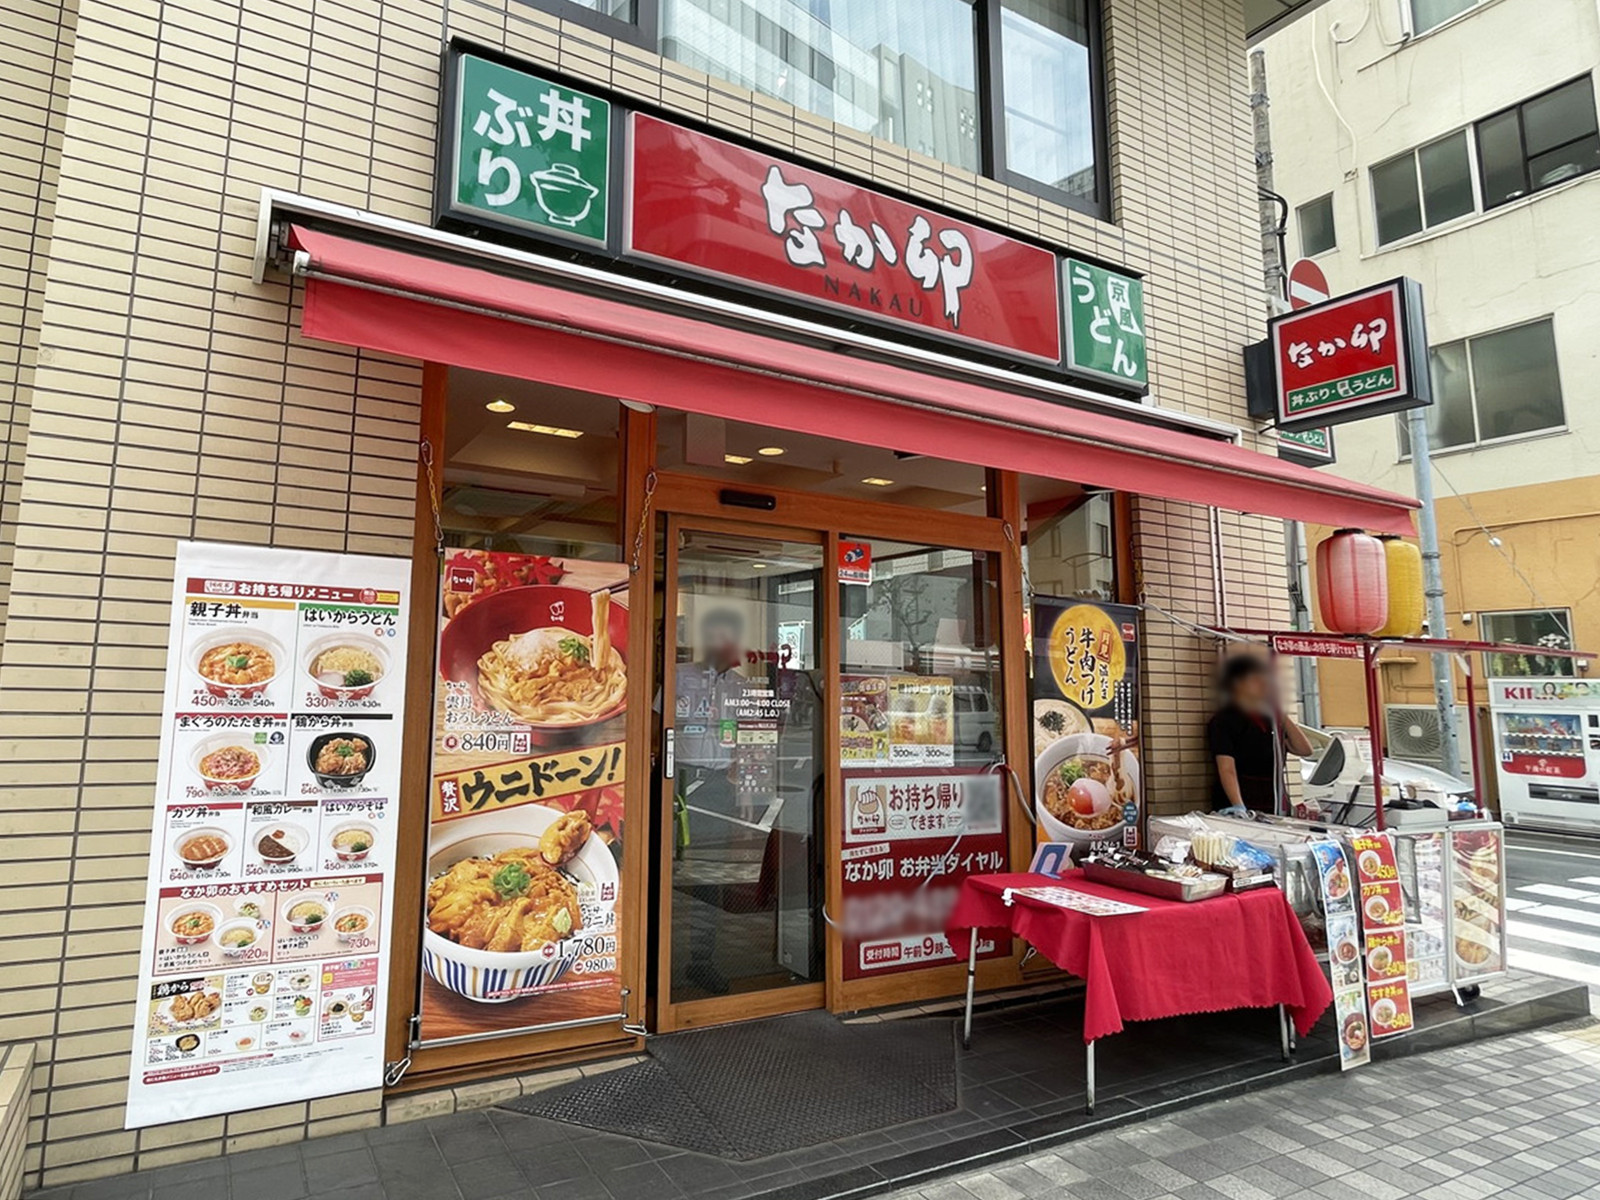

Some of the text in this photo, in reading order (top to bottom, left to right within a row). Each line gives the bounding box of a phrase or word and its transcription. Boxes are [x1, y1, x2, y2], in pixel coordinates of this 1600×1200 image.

[761, 164, 974, 329] なか卯
[823, 273, 924, 317] NAKAU
[1071, 265, 1138, 377] うどん
[1287, 317, 1388, 368] なか卯
[237, 581, 354, 600] お持ち帰りメニュー
[189, 601, 259, 619] 親子丼弁当
[304, 608, 396, 626] はいからうどん
[1065, 627, 1078, 685] うどん
[1079, 628, 1096, 705] 牛肉つけ
[191, 696, 225, 707] 450円
[305, 697, 336, 708] 330円
[770, 699, 791, 708] CLOSE
[446, 711, 514, 724] おろしうどん
[461, 733, 508, 751] 840円
[441, 780, 460, 813] 贅沢
[889, 782, 964, 812] お持ち帰り
[324, 801, 384, 813] はいからそば
[845, 851, 1004, 882] なか卯 お弁当ダイヤル
[179, 880, 308, 899] なか卯のおすすめセット
[558, 936, 615, 958] 1,780円
[866, 946, 900, 961] 受付時間
